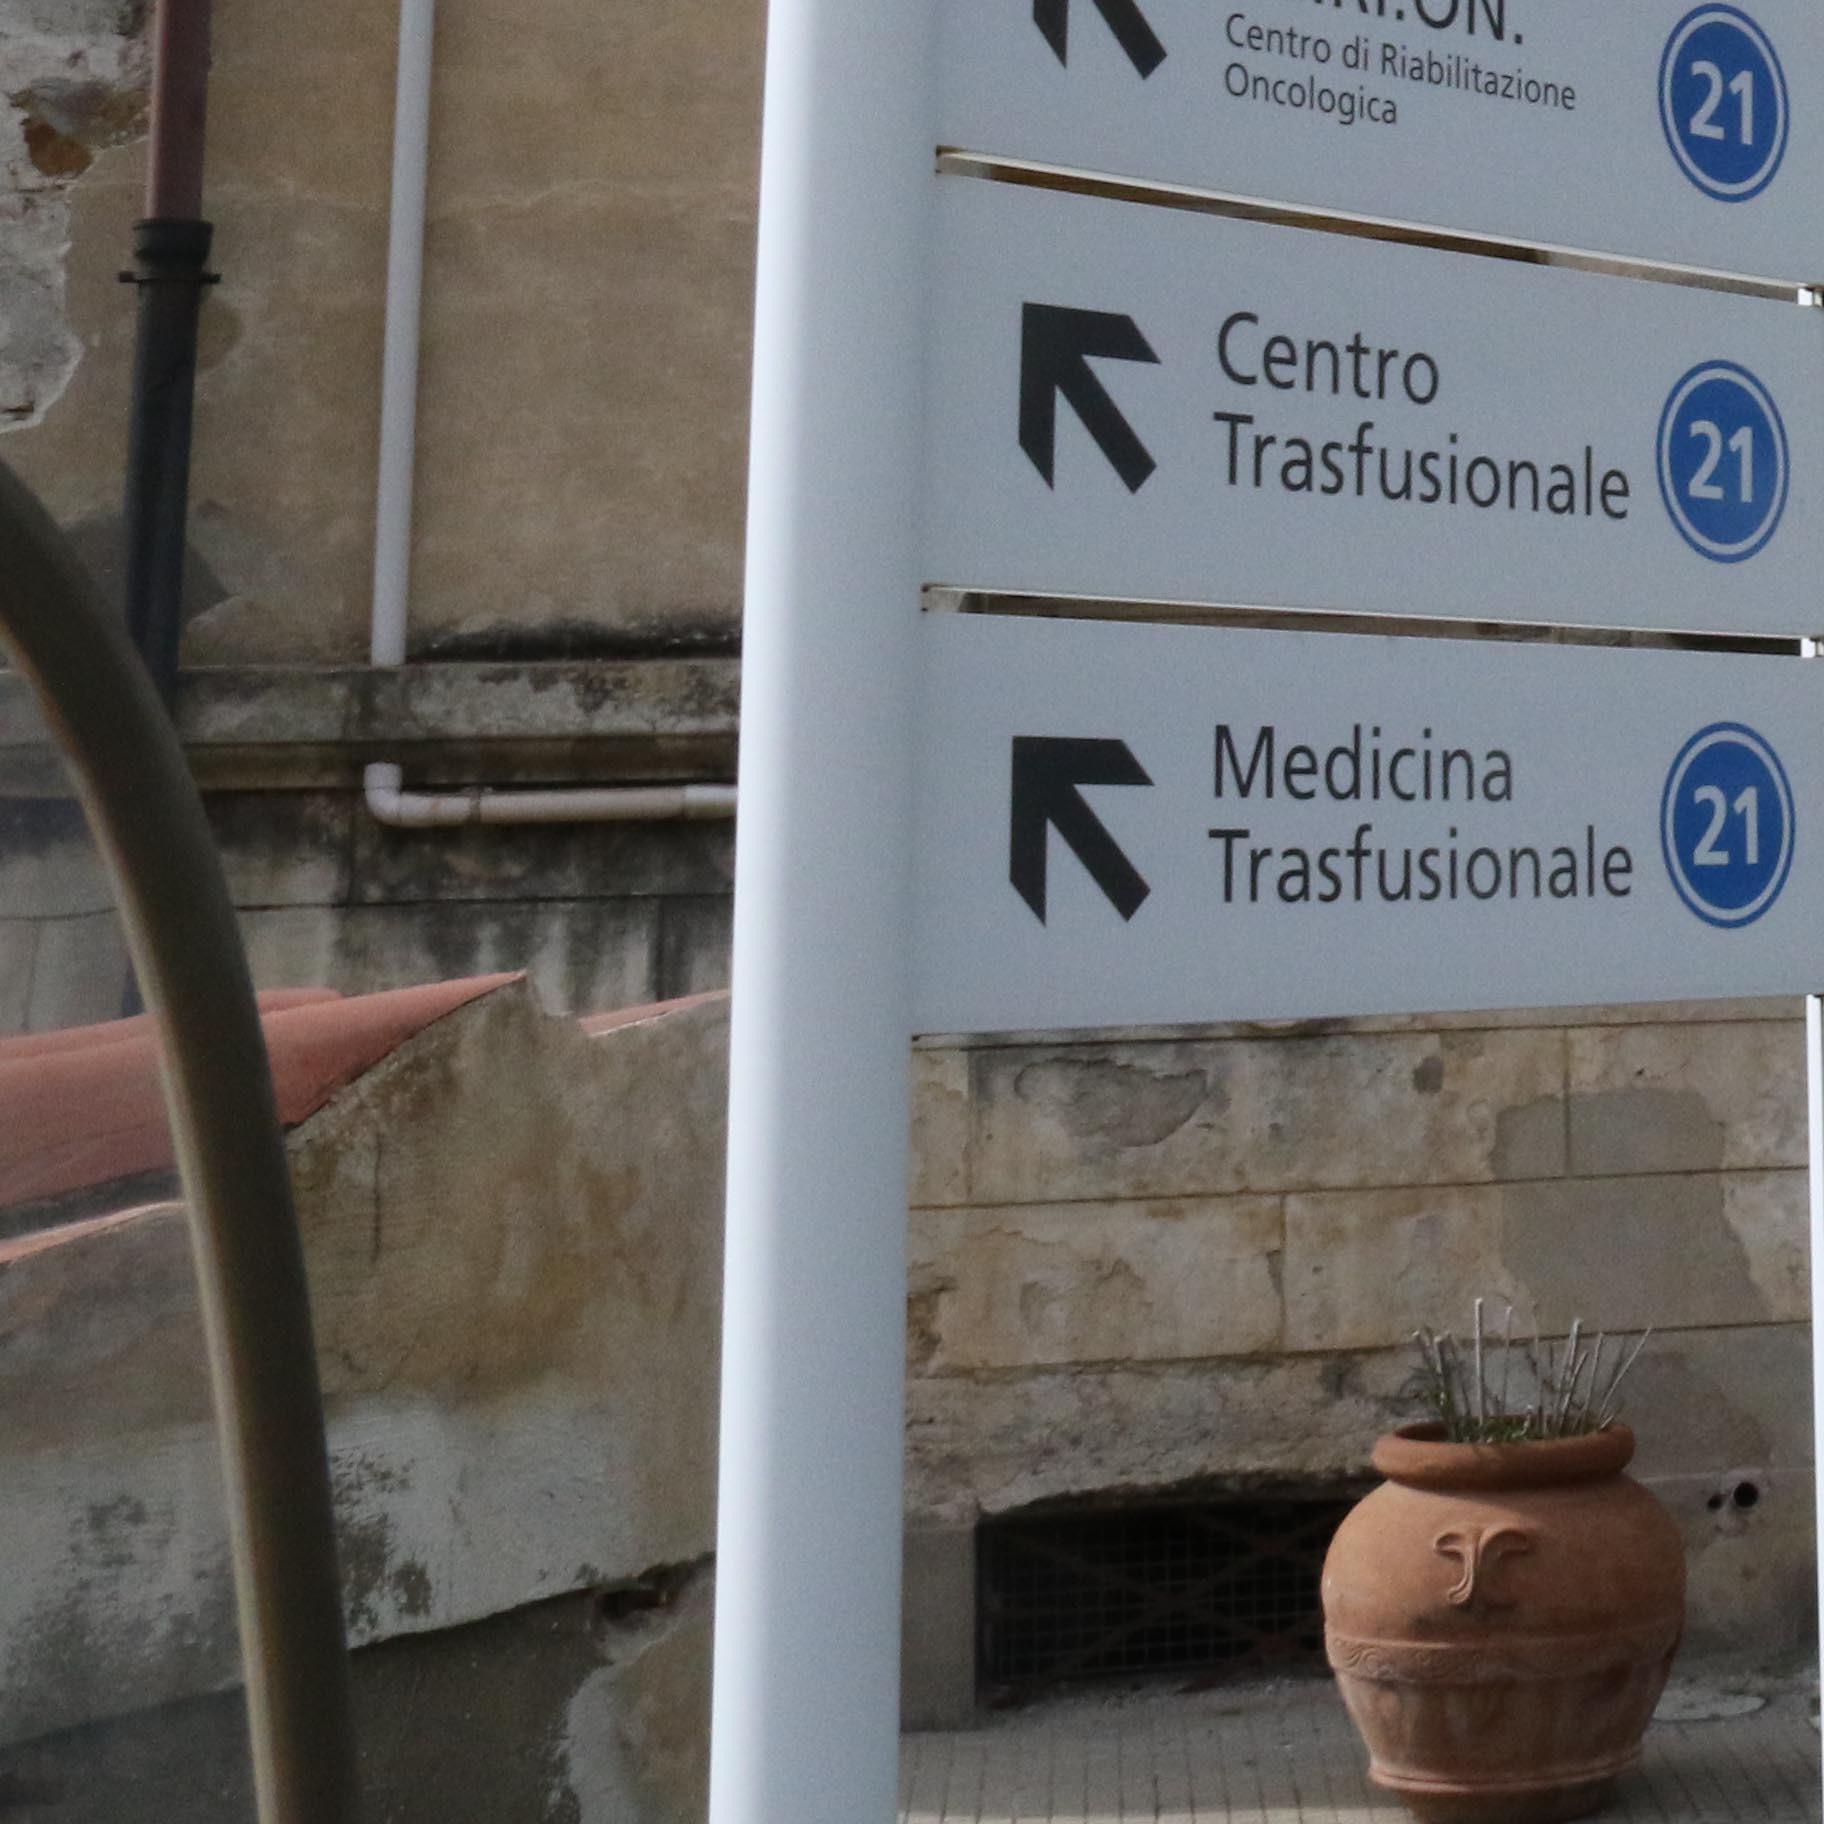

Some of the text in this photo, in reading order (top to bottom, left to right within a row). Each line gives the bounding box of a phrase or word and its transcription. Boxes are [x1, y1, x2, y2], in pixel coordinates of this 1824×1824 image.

[1224, 63, 1397, 125] Oncologica
[1226, 13, 1575, 110] Centro di Riabilitazione
[1690, 61, 1753, 145] 21
[1218, 312, 1439, 405] Centro
[1213, 412, 1629, 519] Trasfusionale
[1689, 420, 1753, 503] 21
[1214, 724, 1512, 802] Medicina
[1208, 824, 1632, 903] Trasfusionale
[1694, 785, 1758, 865] 21
